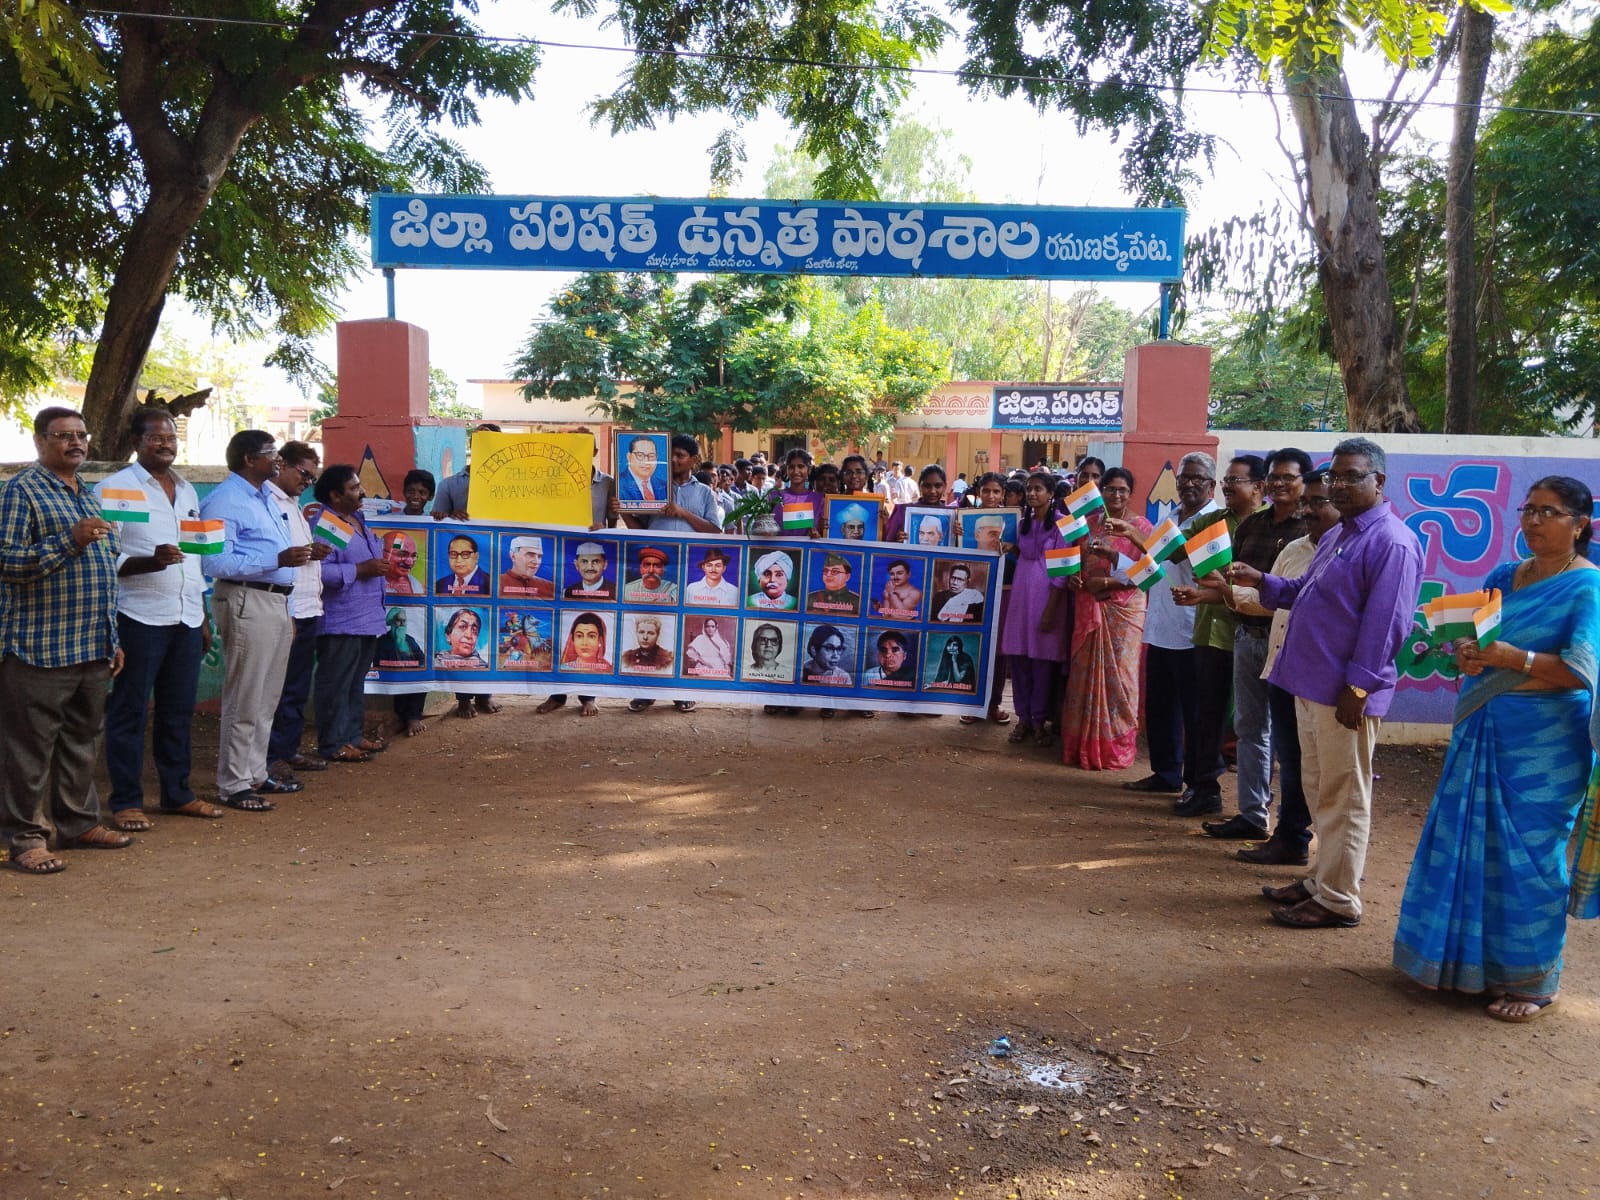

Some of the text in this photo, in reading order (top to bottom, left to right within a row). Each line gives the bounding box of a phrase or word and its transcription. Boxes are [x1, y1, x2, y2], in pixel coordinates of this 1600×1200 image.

[390, 199, 493, 254] జిల్లా
[509, 202, 658, 262] పరిషత్
[678, 206, 819, 268] ఉన్నత
[998, 391, 1050, 415] జిల్లా
